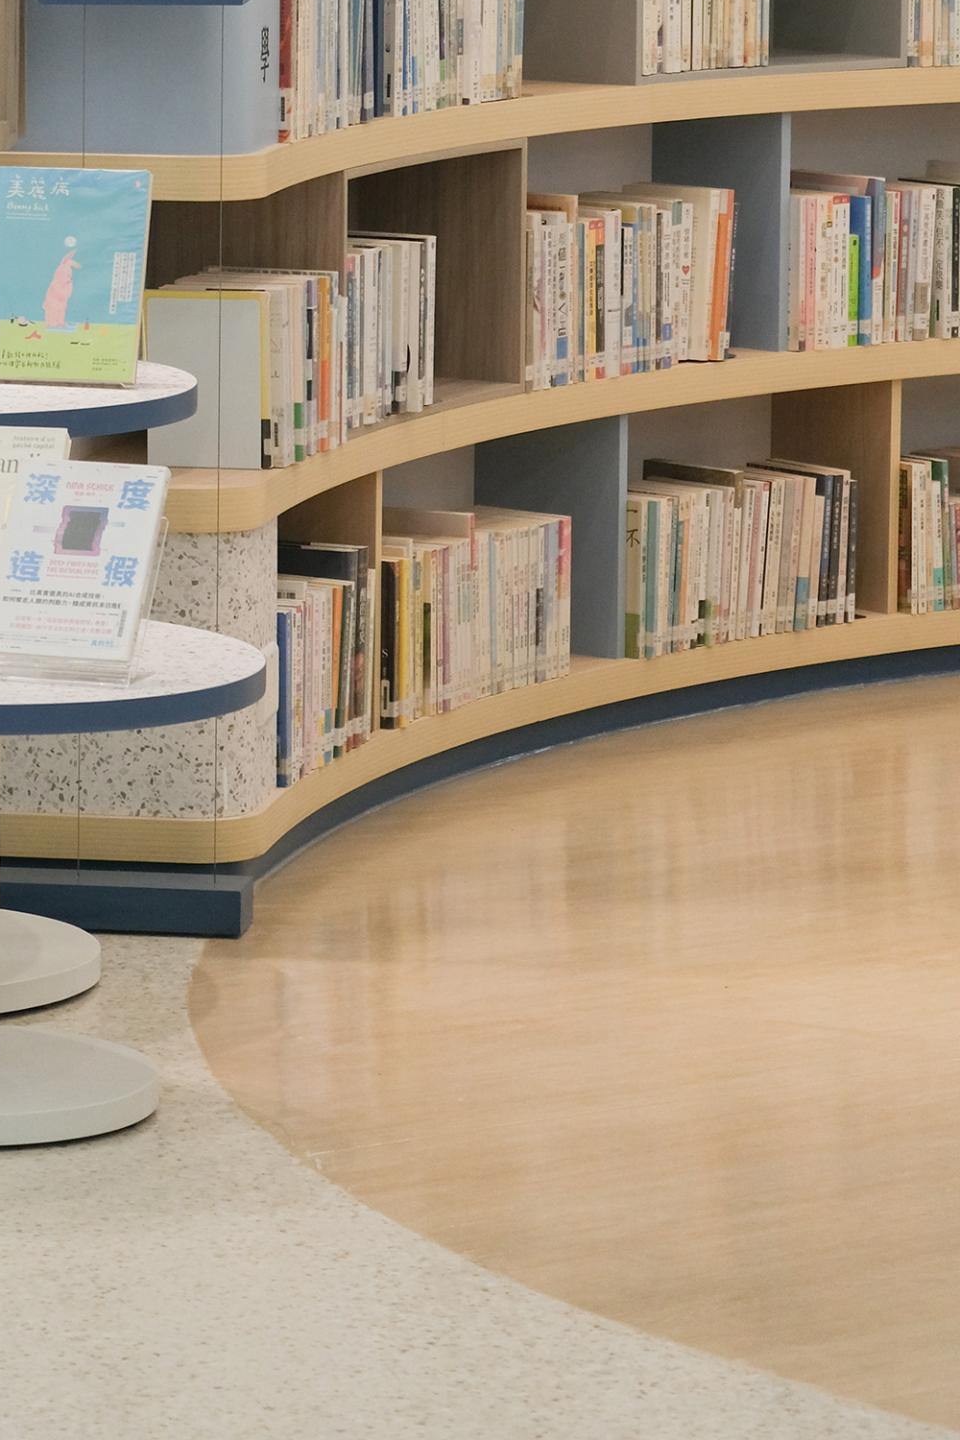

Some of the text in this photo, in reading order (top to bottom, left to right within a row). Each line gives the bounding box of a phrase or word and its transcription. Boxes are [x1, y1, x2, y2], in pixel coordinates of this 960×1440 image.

[23, 472, 155, 511] 深 度
[6, 550, 139, 588] 造 假
